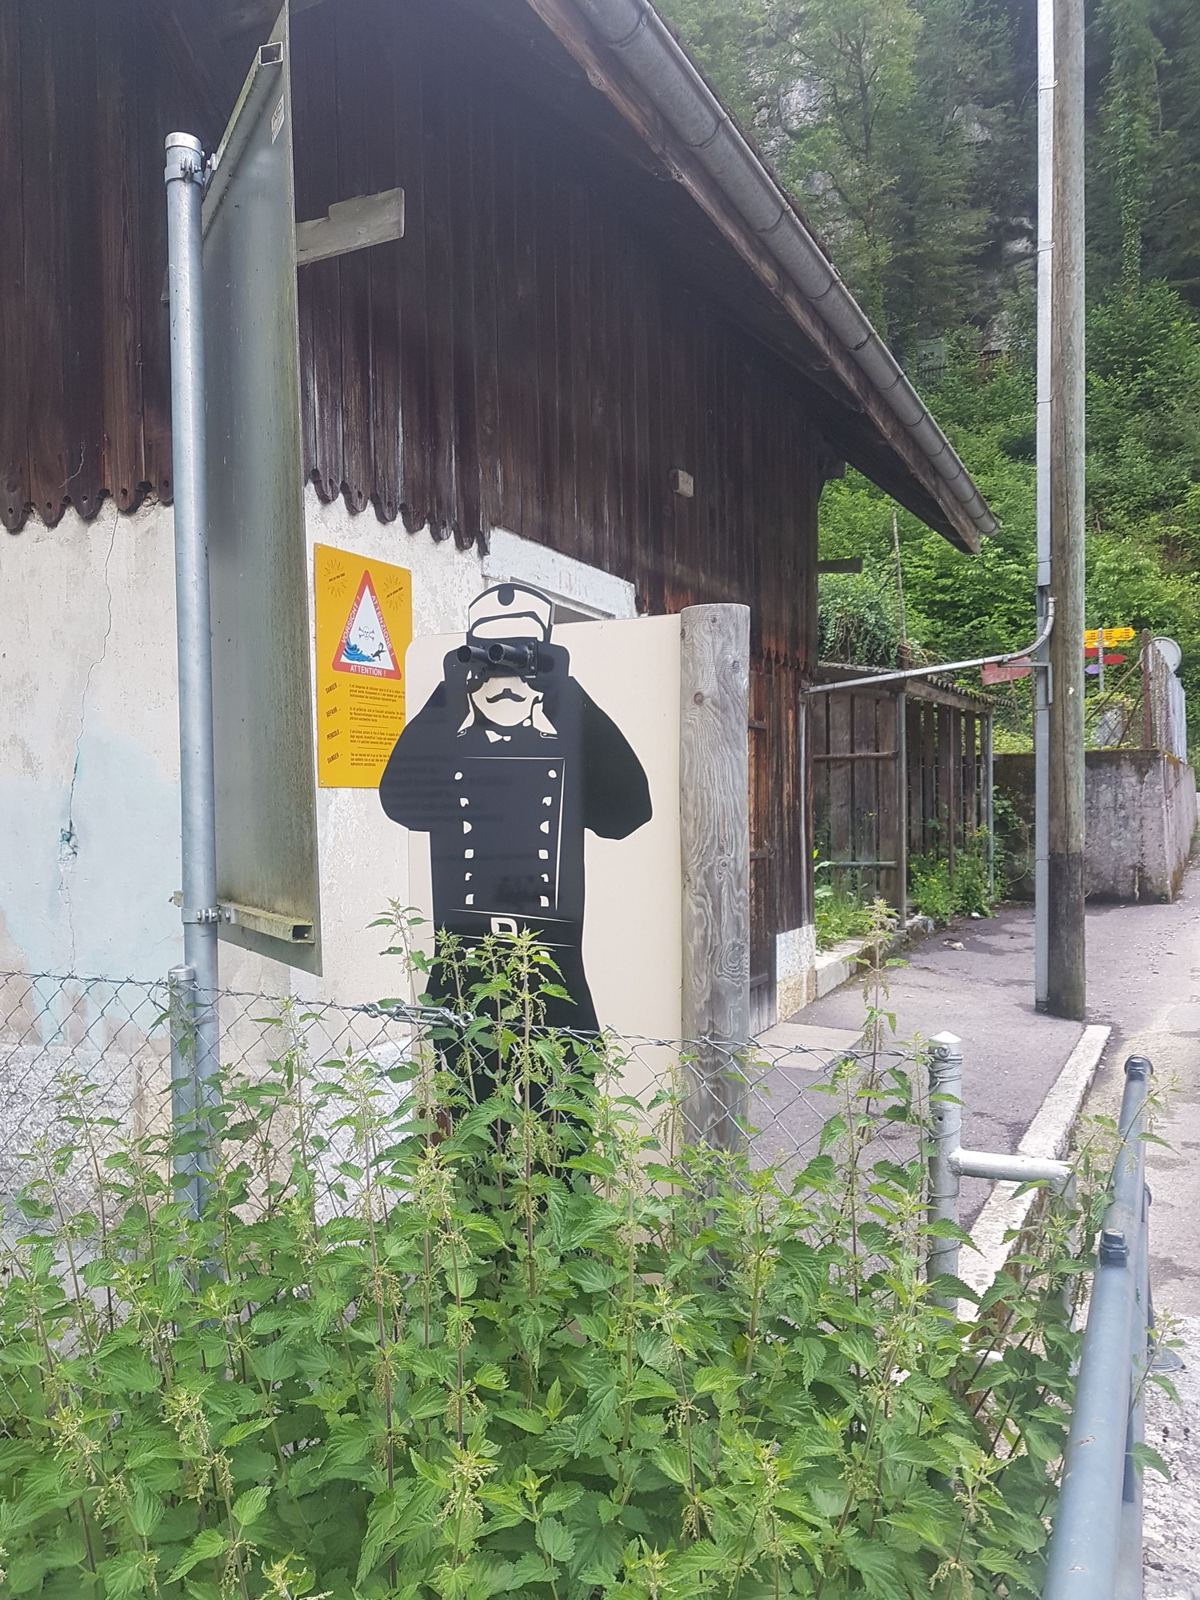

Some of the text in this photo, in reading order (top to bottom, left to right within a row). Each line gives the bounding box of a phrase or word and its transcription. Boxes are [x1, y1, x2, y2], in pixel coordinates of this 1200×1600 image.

[341, 602, 359, 644] VORSICHT
[371, 595, 392, 648] ATTENZIONE
[349, 664, 383, 676] ATTENTION
